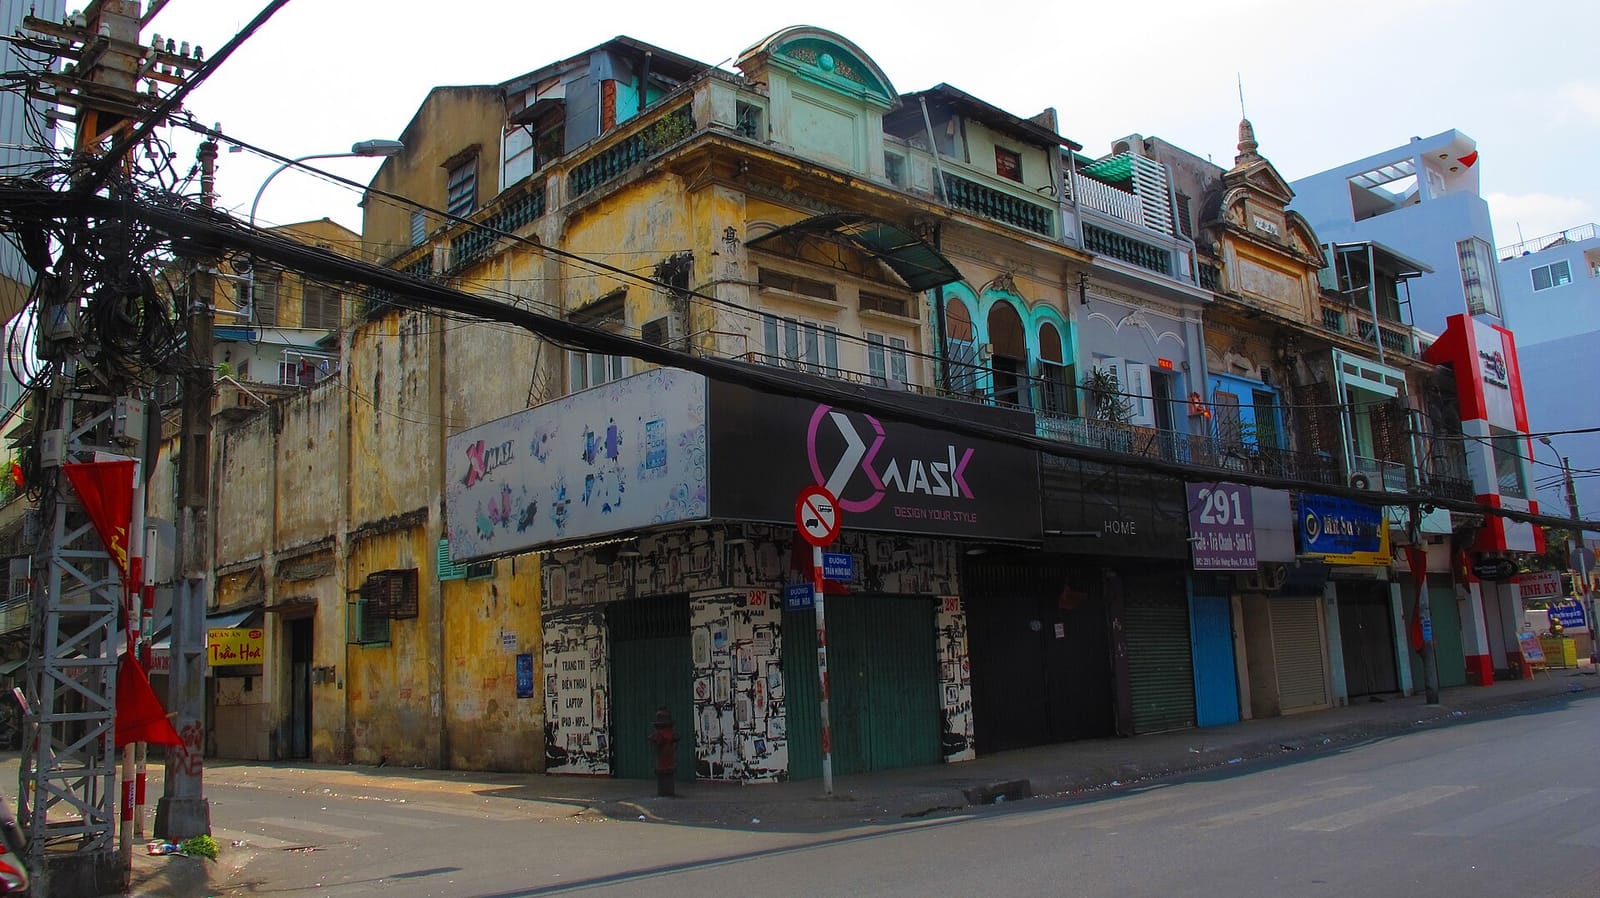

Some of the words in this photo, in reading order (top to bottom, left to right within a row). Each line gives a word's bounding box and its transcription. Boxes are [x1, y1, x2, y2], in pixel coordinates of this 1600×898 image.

[894, 505, 927, 520] DESIGN
[928, 508, 951, 521] YOUR
[952, 510, 977, 523] STYLE
[1198, 488, 1245, 526] 291
[1104, 520, 1136, 535] HOME
[749, 590, 768, 606] 287
[944, 599, 959, 612] 287
[566, 698, 584, 708] LAPTOP
